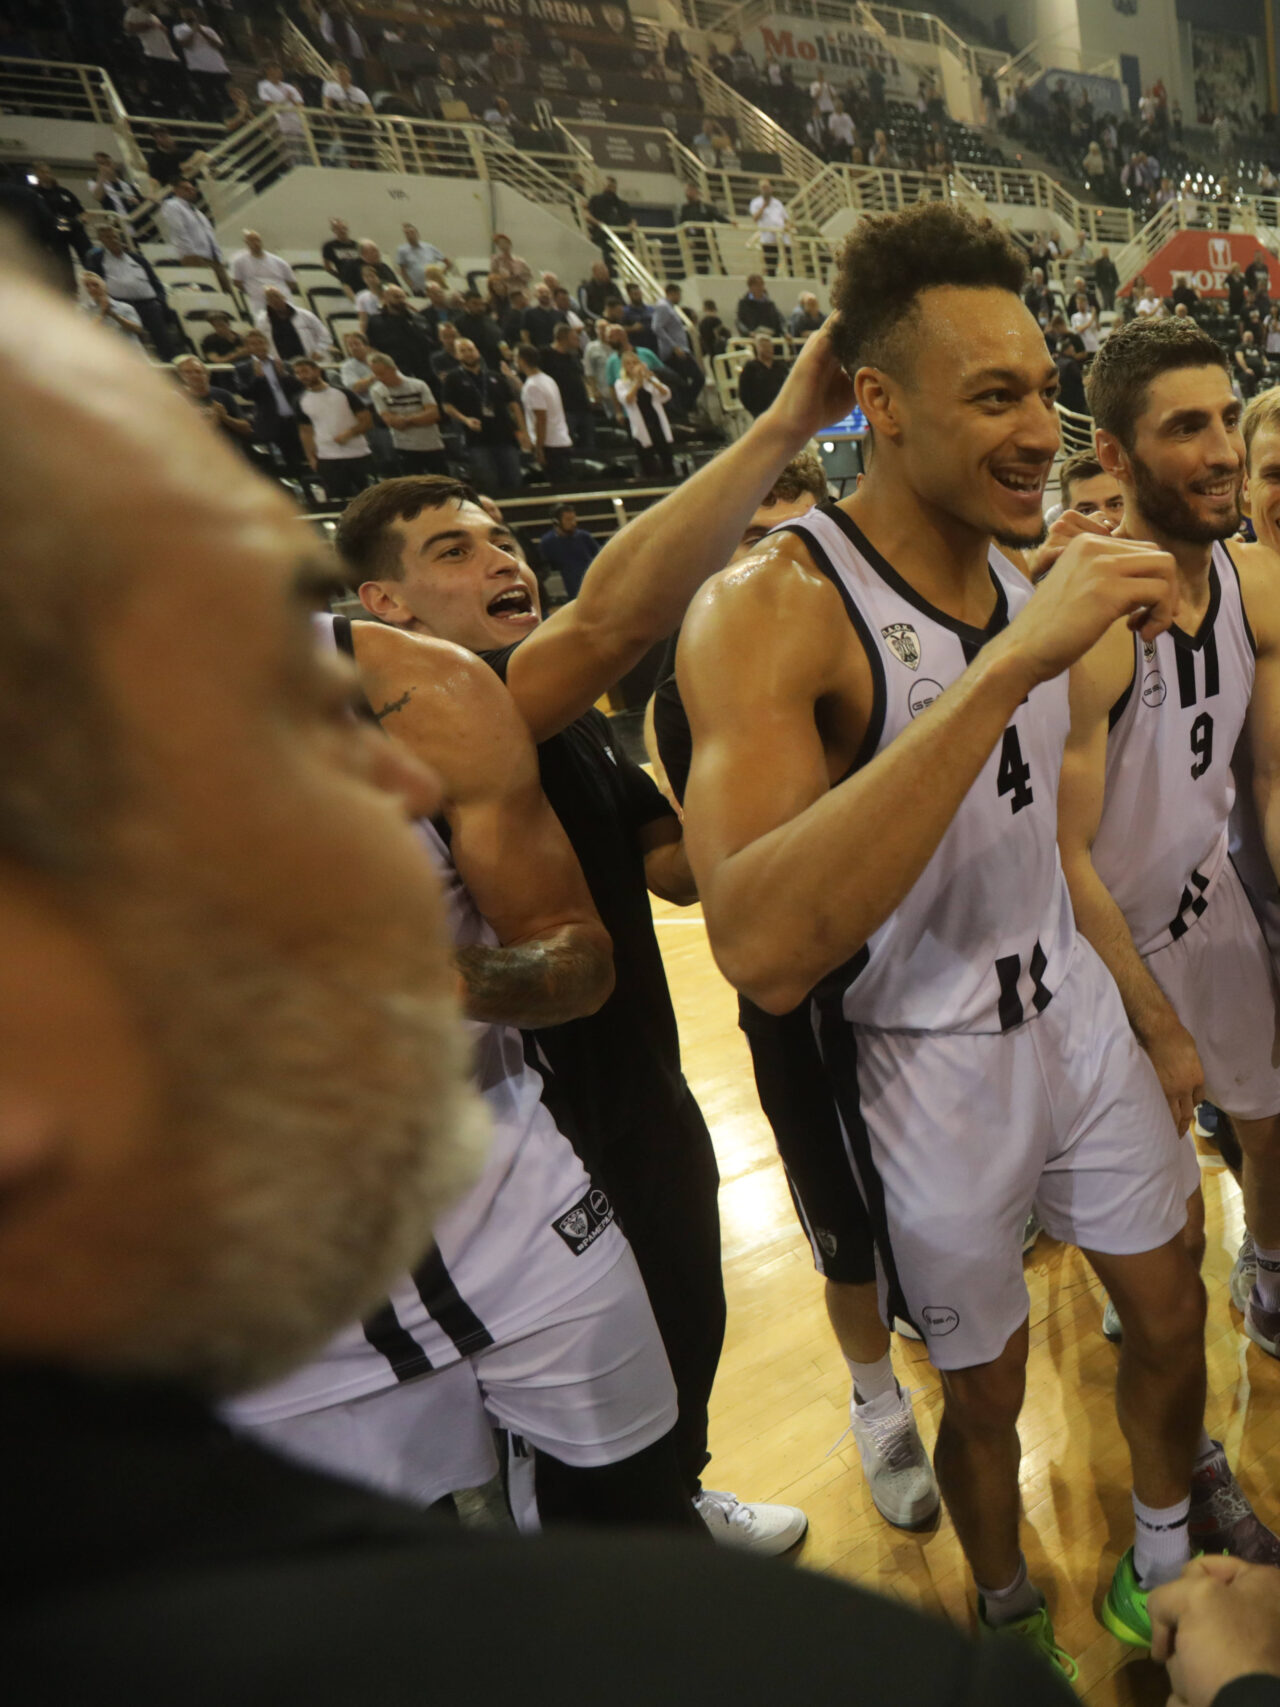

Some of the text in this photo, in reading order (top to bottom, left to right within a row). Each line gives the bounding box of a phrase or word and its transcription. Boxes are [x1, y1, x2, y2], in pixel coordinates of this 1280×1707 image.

[527, 0, 596, 27] ARENA
[996, 724, 1034, 815] 4
[1190, 711, 1214, 781] 9
